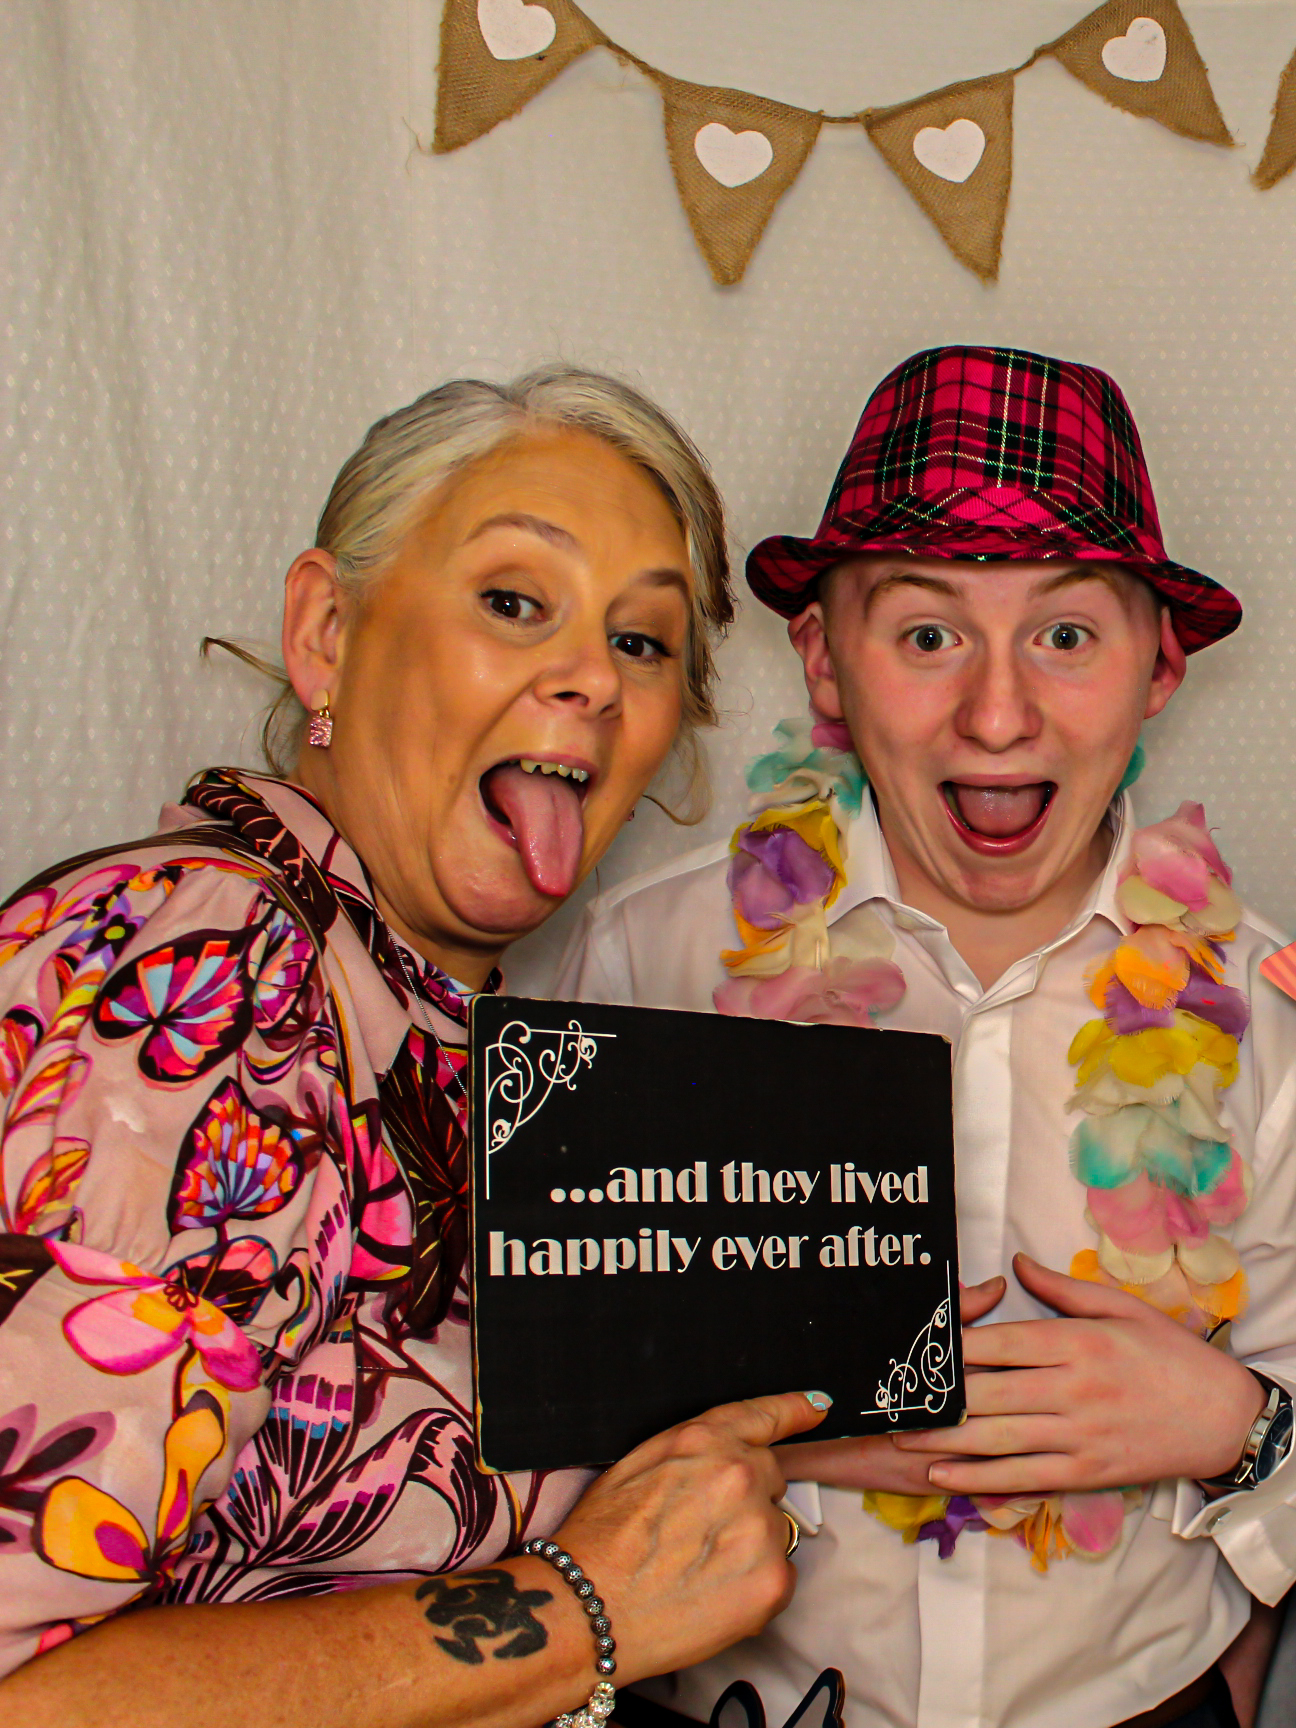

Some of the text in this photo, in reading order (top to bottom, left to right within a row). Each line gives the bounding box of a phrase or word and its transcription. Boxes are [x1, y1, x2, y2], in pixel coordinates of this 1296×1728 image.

[550, 1159, 929, 1205] ...and they lived
[488, 1224, 933, 1277] happily ever after.
